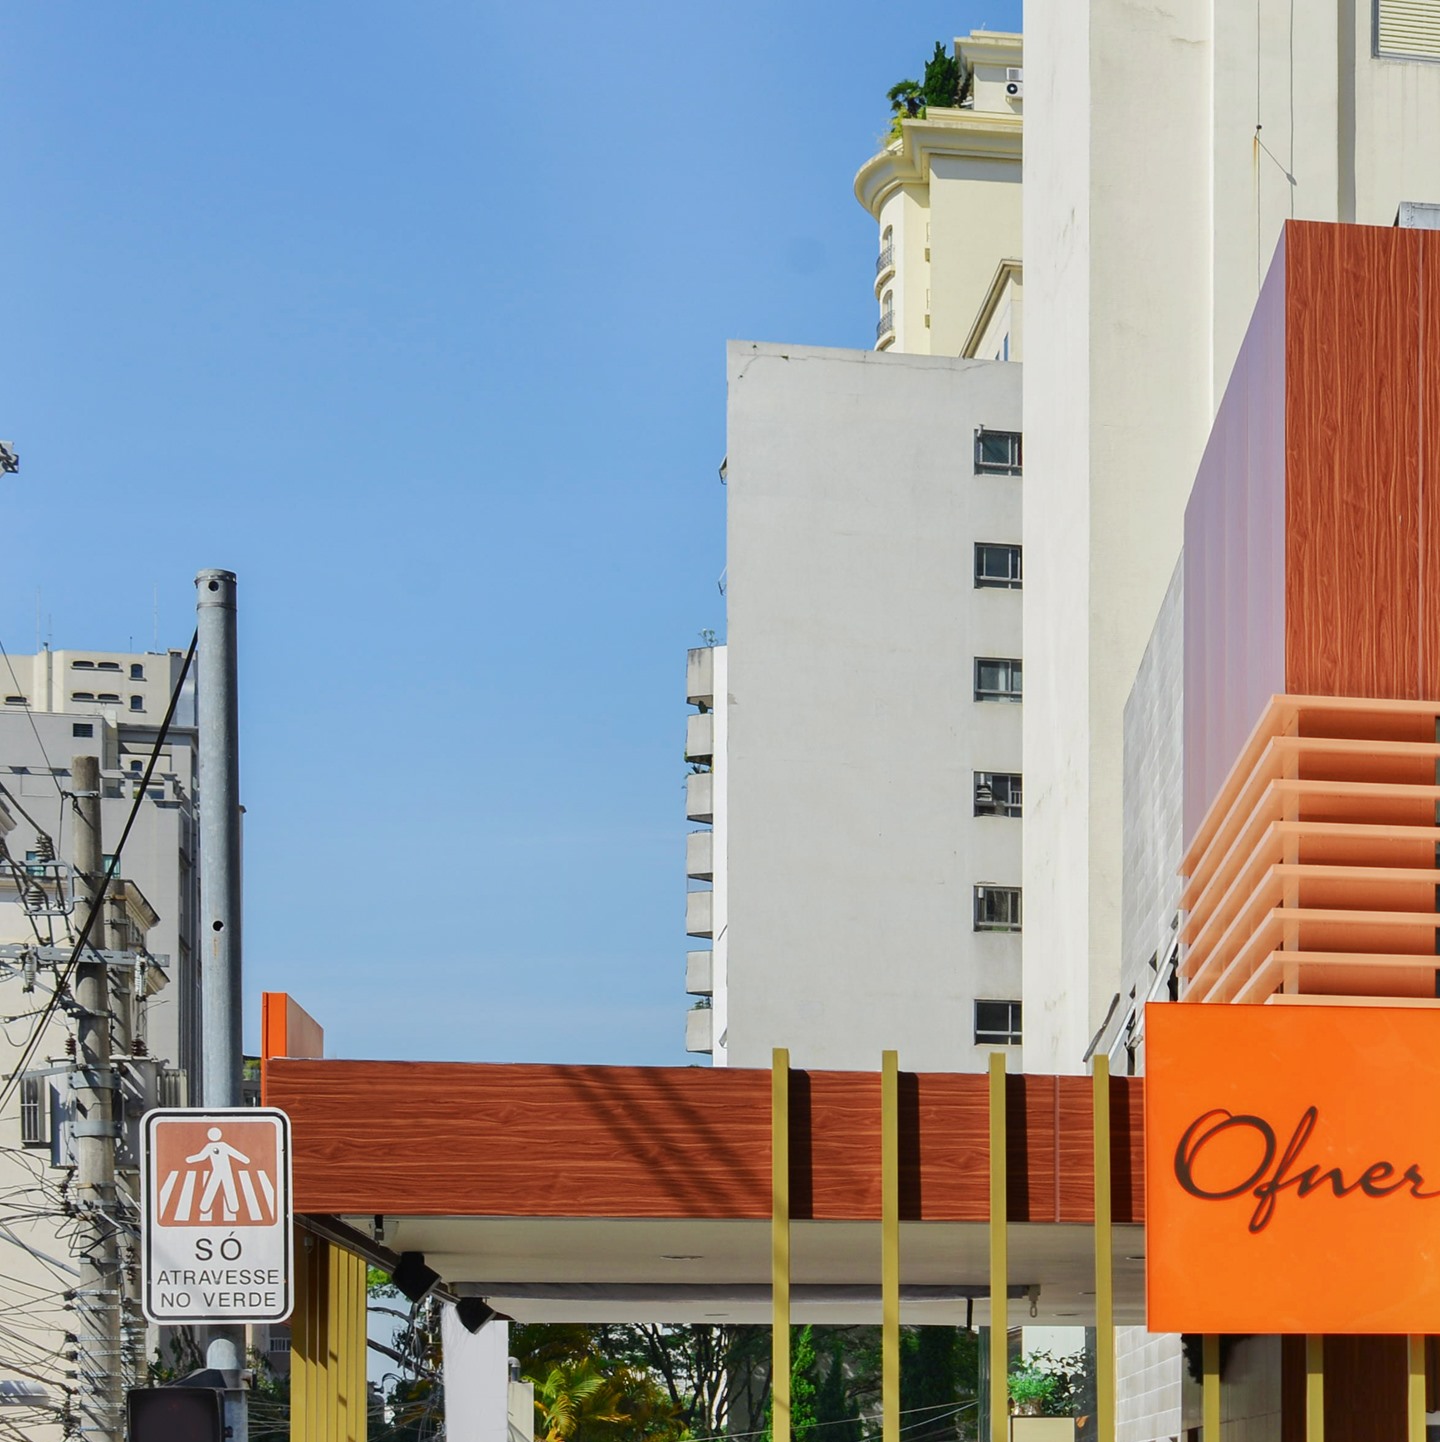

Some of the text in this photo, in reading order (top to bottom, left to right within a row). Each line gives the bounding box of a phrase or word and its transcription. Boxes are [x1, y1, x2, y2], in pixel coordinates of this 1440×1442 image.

[195, 1231, 242, 1261] SÓ
[157, 1269, 279, 1285] ATRAVESSE
[161, 1292, 276, 1307] NO VERDE
